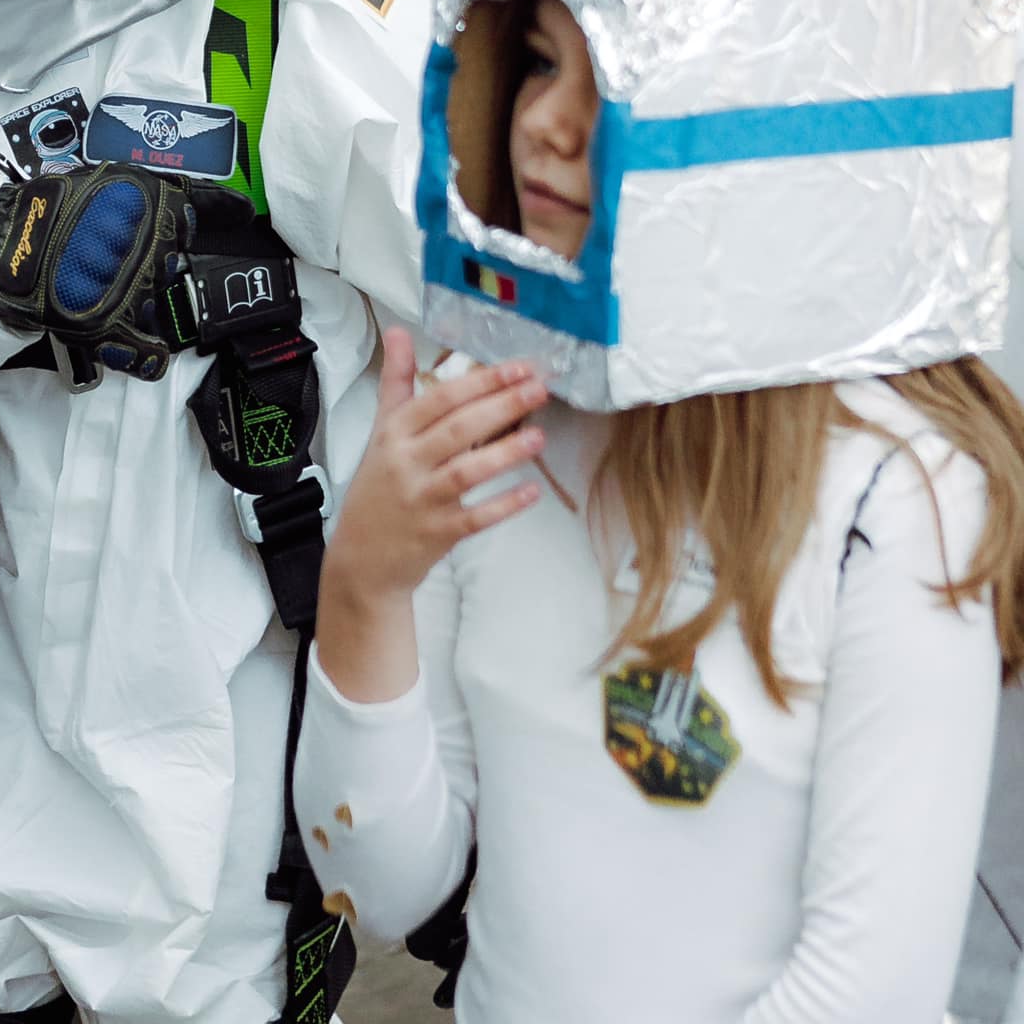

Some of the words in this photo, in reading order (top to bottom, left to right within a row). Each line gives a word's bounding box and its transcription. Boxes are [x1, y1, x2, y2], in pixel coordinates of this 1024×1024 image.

[0, 107, 30, 126] SPACE
[31, 87, 80, 112] EXPLORER
[144, 120, 177, 144] NASA
